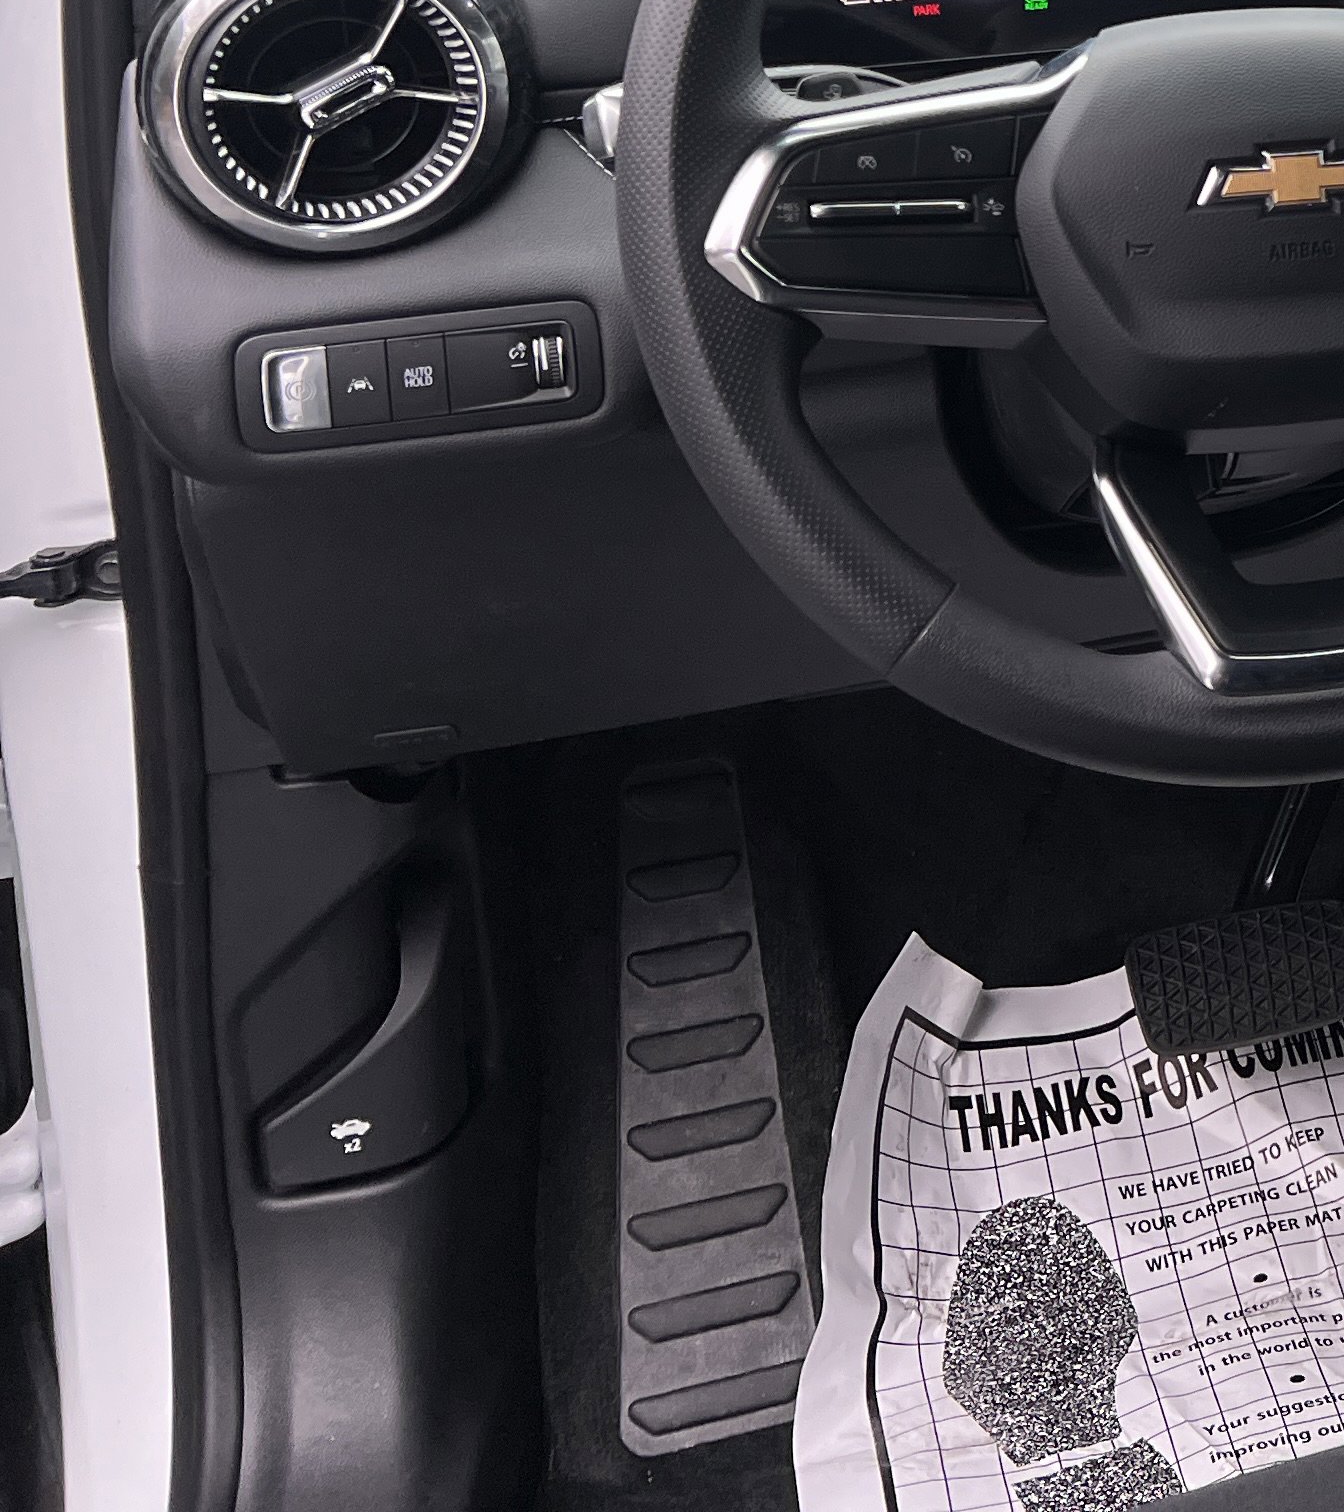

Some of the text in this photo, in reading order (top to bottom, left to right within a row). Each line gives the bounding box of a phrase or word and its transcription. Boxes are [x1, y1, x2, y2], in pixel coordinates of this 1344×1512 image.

[912, 3, 941, 16] PARK
[1268, 240, 1335, 261] AIRBAG
[403, 366, 433, 379] AUTO
[404, 374, 433, 388] HOLD
[948, 1074, 1124, 1153] THANKS
[1132, 1052, 1219, 1119] FOR
[344, 1138, 362, 1153] x2
[1118, 1127, 1325, 1200] WE HAVE TRIED TO KEEP
[1126, 1163, 1338, 1236] YOUR CARPETING CLEAN
[1145, 1207, 1343, 1272] WITH THIS PAPER MAT
[1205, 1314, 1219, 1327] A
[1308, 1286, 1322, 1299] is
[1152, 1347, 1182, 1364] the
[1188, 1330, 1232, 1351] most
[1237, 1313, 1327, 1338] important
[1198, 1363, 1216, 1376] in
[1222, 1351, 1252, 1366] the
[1257, 1337, 1310, 1356] world
[1314, 1336, 1334, 1348] to
[1202, 1415, 1250, 1436] Your
[1208, 1428, 1312, 1464] improving
